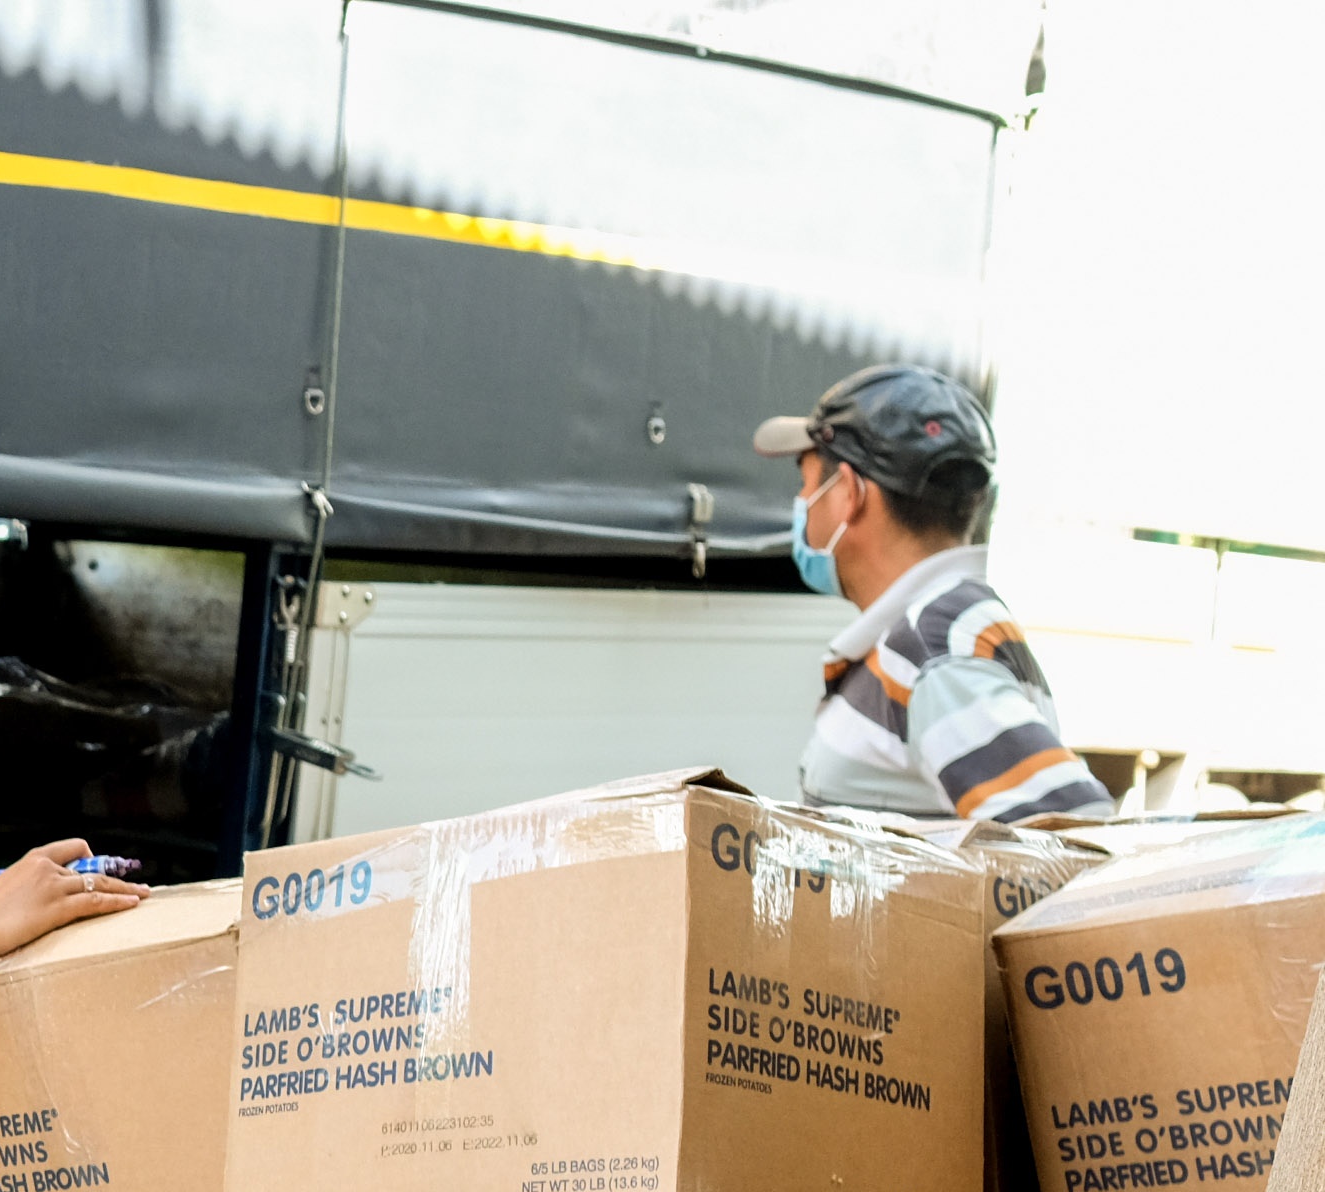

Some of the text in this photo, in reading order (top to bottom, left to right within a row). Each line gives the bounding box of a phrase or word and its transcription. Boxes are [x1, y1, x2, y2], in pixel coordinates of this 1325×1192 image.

[252, 860, 372, 920] G0019
[708, 967, 790, 1009] LAMB'S
[1024, 947, 1187, 1011] G0019
[244, 1003, 319, 1037] LAMB'S
[707, 1004, 883, 1066] SIDE O'BROWNS
[241, 1023, 428, 1069] SIDE O'BROWNS
[240, 1050, 493, 1101] PARFRIED HASH BROWN
[705, 1072, 772, 1094] FROZEN POTATOES
[707, 1039, 931, 1112] PARFRIED HASH BROWN
[238, 1102, 299, 1117] FROZEN POTATOES
[1051, 1077, 1294, 1130] LAMB'S SUPREM
[1058, 1113, 1285, 1162] SIDE O'BROWN
[32, 1162, 110, 1192] BROWN
[549, 1180, 568, 1192] WT
[572, 1179, 586, 1191] 30
[590, 1178, 605, 1191] LB
[551, 1161, 567, 1174] LB
[571, 1159, 605, 1173] BAGS
